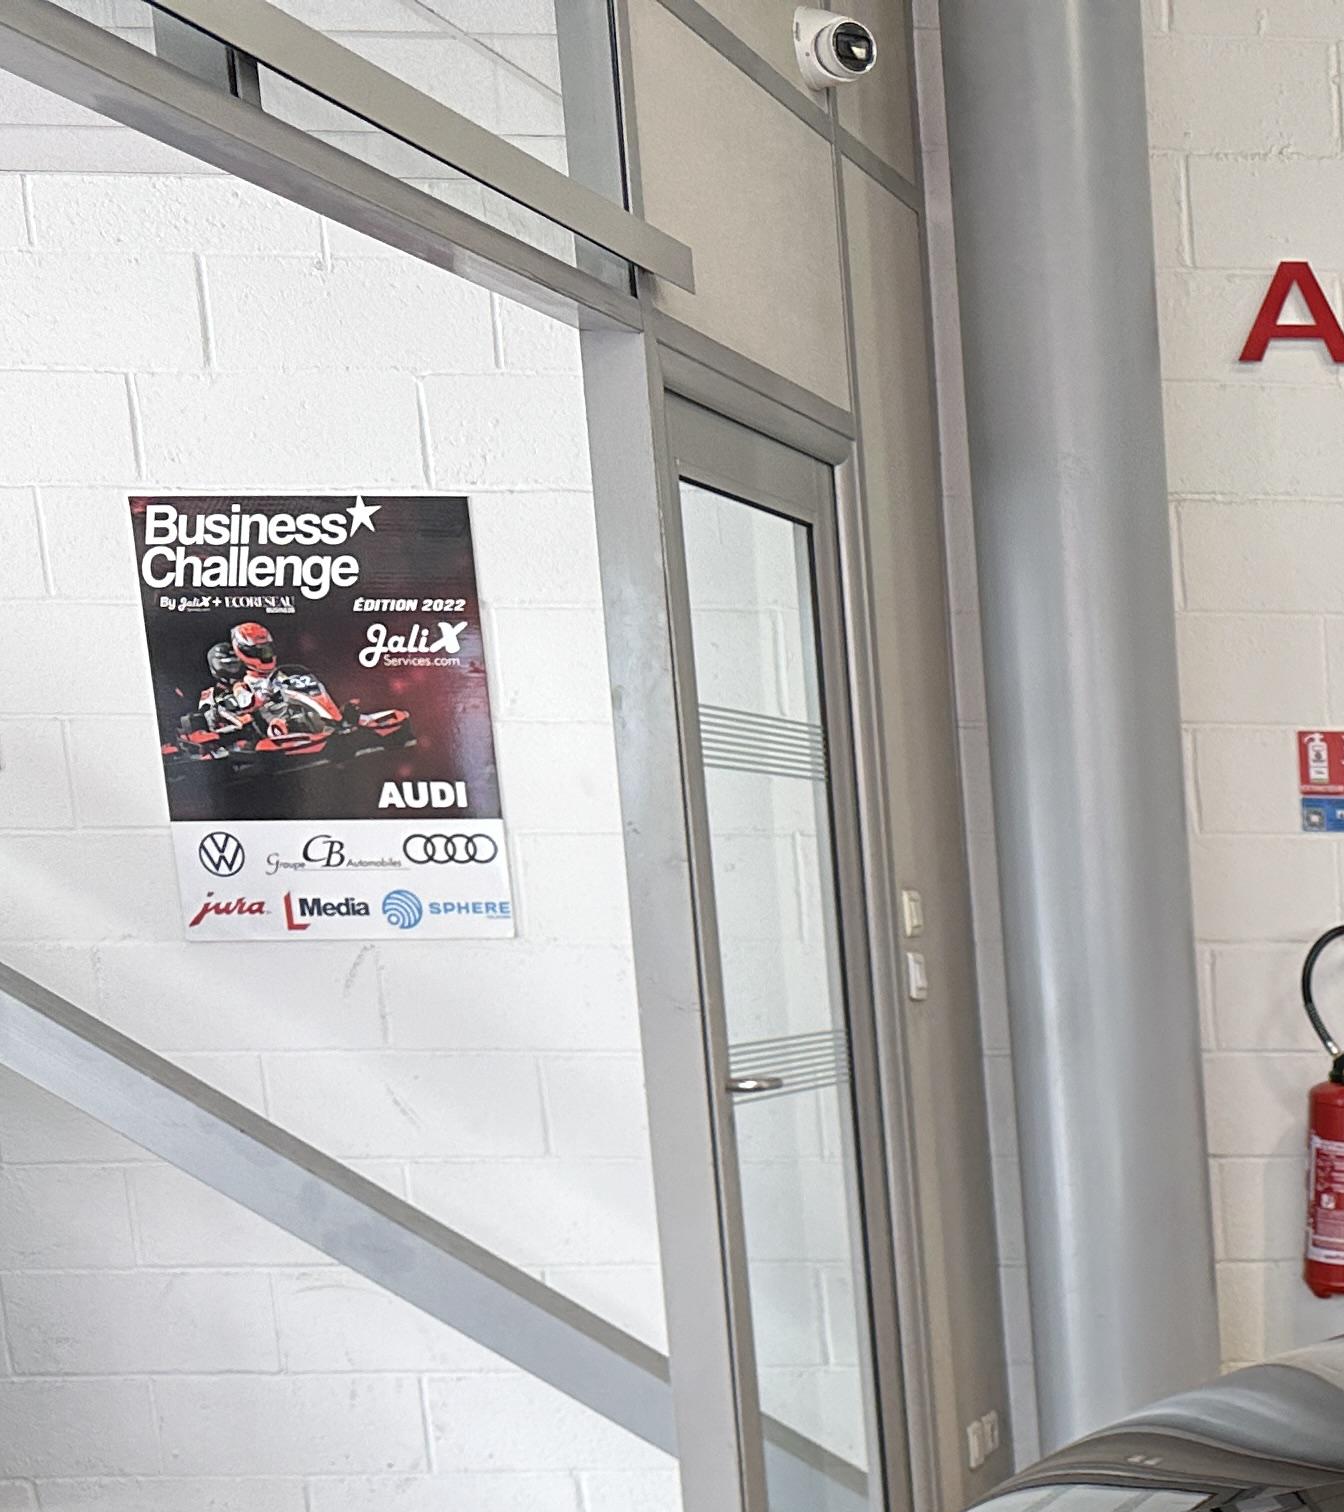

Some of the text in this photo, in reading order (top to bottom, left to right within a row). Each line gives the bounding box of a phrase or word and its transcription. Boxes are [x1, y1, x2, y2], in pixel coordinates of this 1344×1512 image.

[145, 503, 349, 547] Business
[141, 545, 361, 600] Challenge
[160, 596, 177, 611] By
[353, 596, 467, 612] ÉDITION 2022
[358, 621, 469, 668] JaliX
[383, 654, 461, 667] Services.com
[378, 780, 469, 809] AUDI
[265, 852, 306, 876] Groupe
[302, 834, 346, 869] CB
[189, 891, 266, 928] jura
[428, 902, 512, 915] SPHERE
